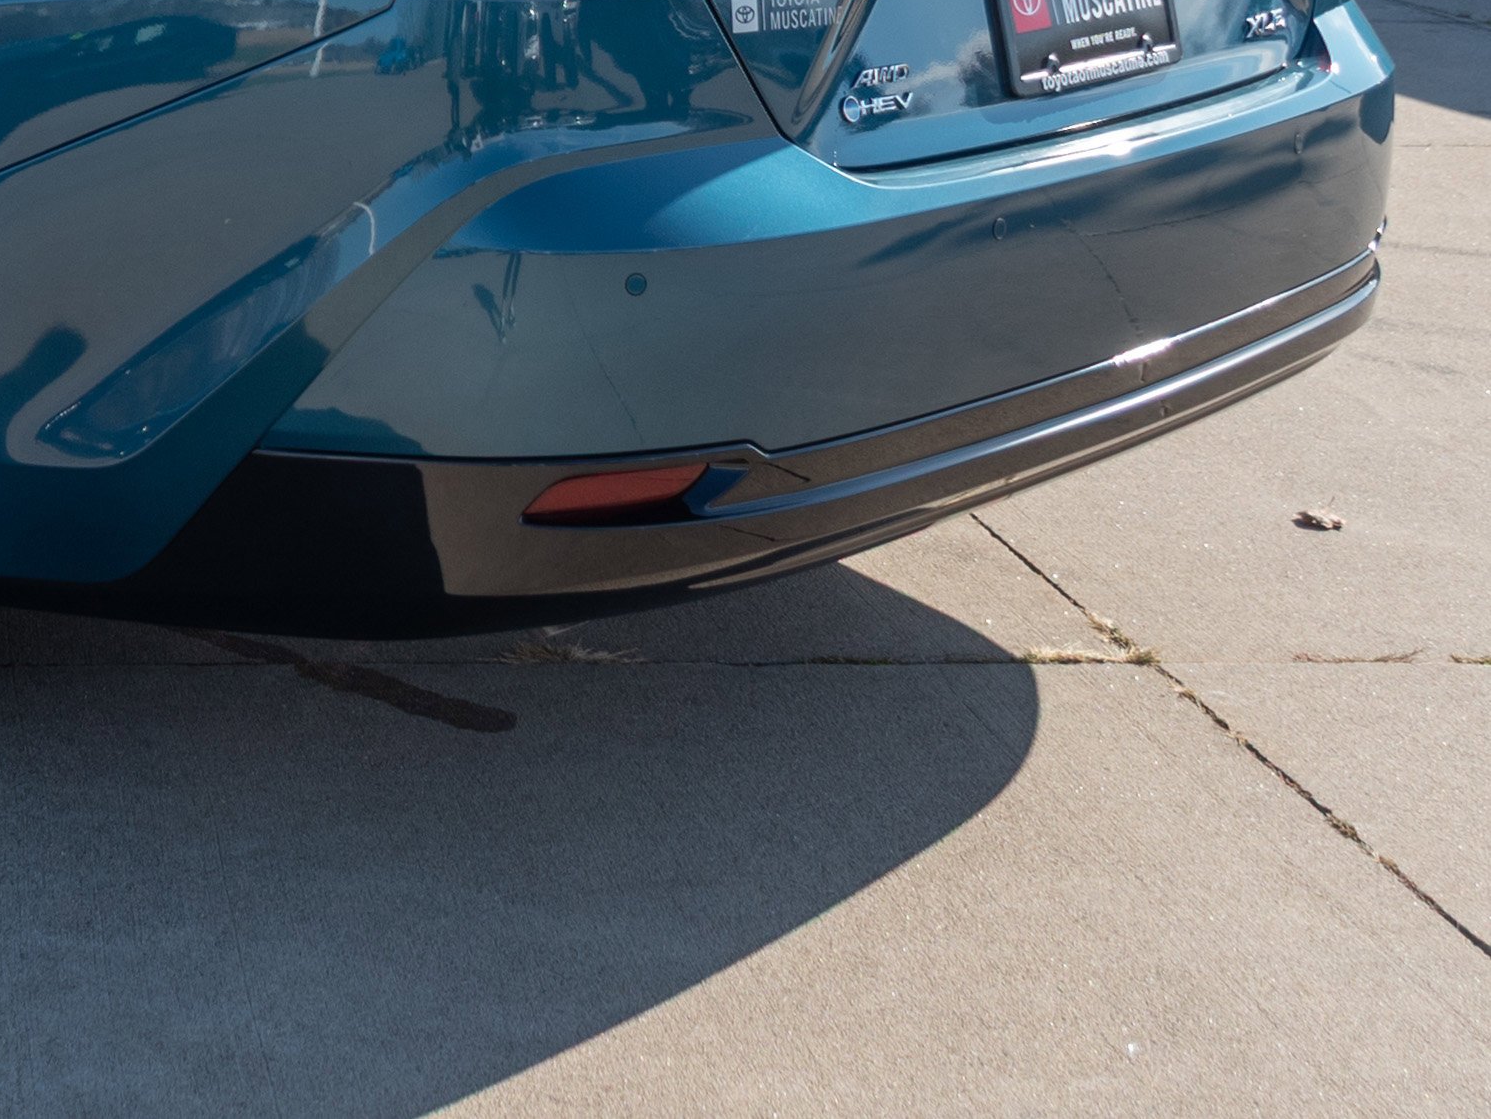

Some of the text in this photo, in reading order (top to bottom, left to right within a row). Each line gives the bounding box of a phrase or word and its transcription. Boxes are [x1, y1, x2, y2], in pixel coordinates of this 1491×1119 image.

[770, 5, 843, 30] MUSCATINE
[1070, 37, 1091, 50] WHEN
[852, 64, 909, 88] AWD
